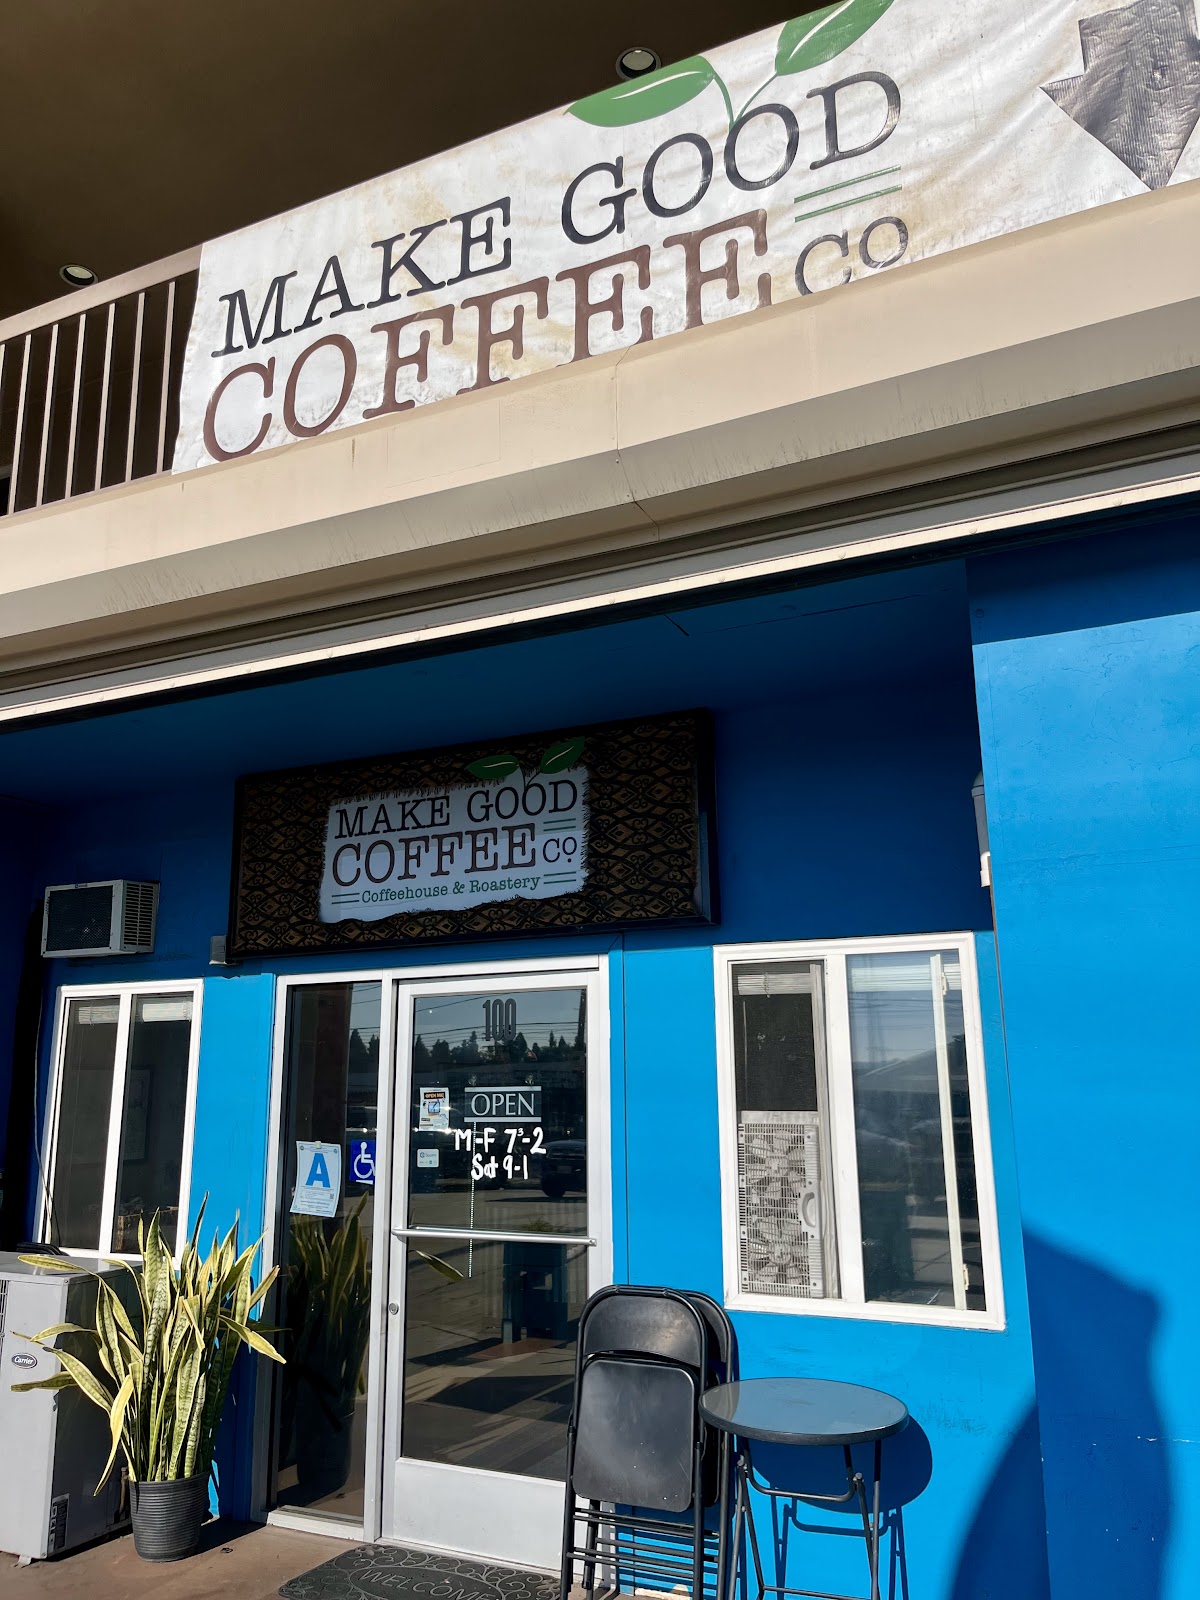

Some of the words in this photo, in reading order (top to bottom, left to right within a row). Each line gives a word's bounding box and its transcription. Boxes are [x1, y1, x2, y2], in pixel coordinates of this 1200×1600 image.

[211, 196, 512, 358] MAKE
[561, 70, 902, 245] GOOD
[202, 208, 773, 462] COFFEE
[334, 795, 451, 840] MAKE
[466, 779, 578, 823] GOOD
[332, 822, 537, 887] COFFEE
[361, 884, 449, 904] Coffeehouse
[452, 881, 465, 895] &
[469, 875, 541, 894] Roastery
[482, 998, 517, 1042] 100
[471, 1093, 535, 1117] OPEN
[454, 1127, 497, 1153] M-F
[305, 1153, 331, 1188] A
[471, 1153, 499, 1181] Sat
[502, 1154, 529, 1180] 9-1
